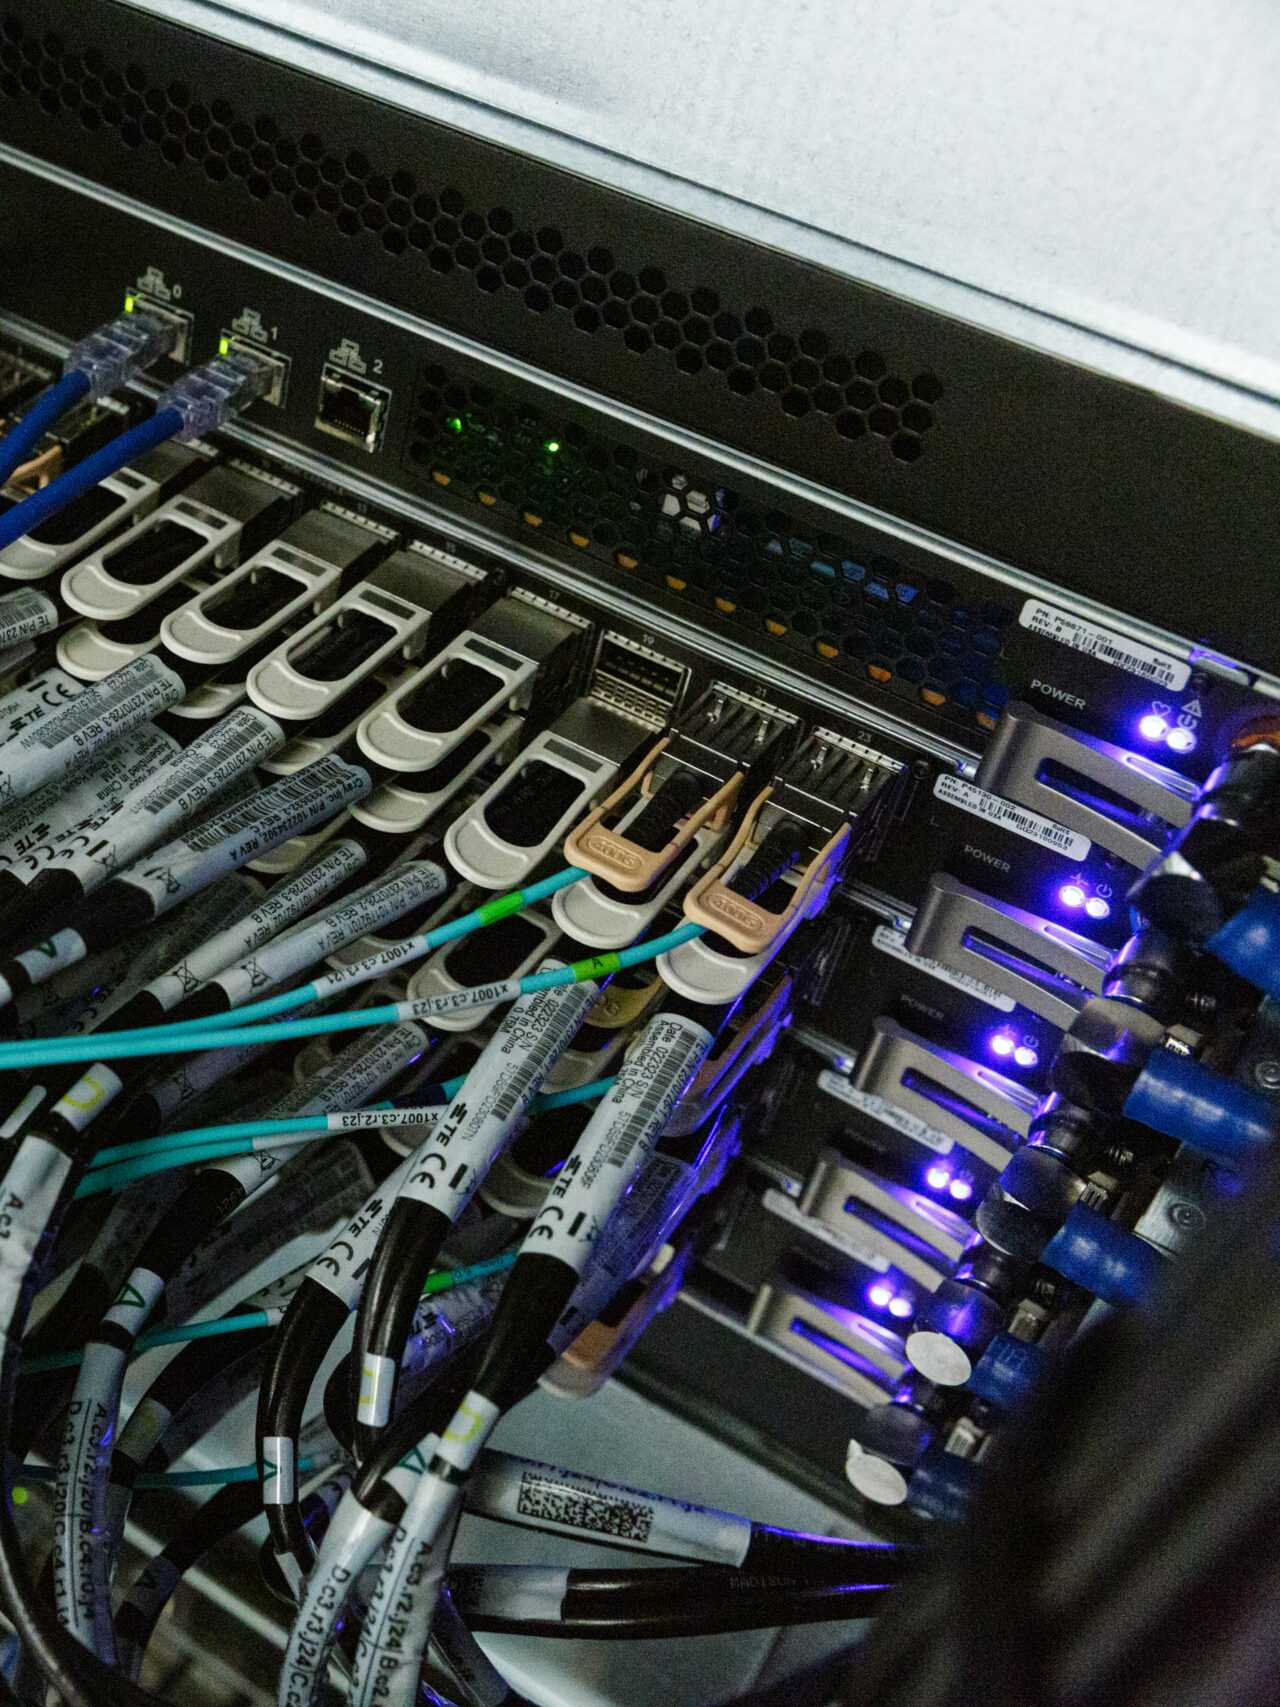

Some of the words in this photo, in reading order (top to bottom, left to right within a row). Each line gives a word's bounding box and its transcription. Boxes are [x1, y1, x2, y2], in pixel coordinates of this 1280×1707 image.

[170, 282, 184, 298] 0
[267, 324, 280, 340] 1
[370, 358, 385, 374] 2
[35, 613, 49, 627] TE
[641, 633, 655, 646] 19
[1081, 646, 1096, 657] USA
[134, 658, 151, 674] Date
[106, 669, 135, 692] 022123
[158, 676, 173, 690] TE
[142, 684, 161, 702] P/N
[754, 685, 768, 697] 21
[1030, 678, 1086, 710] POWER
[24, 705, 44, 723] TE
[236, 712, 254, 728] Date
[80, 721, 102, 740] REV
[201, 709, 245, 743] Assembled
[72, 733, 83, 746] B
[135, 731, 163, 756] Length
[261, 729, 275, 744] TE
[856, 729, 873, 744] 23
[245, 738, 264, 756] P/N
[128, 740, 171, 776] Assembled
[169, 748, 195, 769] China
[99, 759, 126, 781] 1.91M
[341, 766, 355, 780] TE
[97, 778, 122, 802] China
[184, 783, 207, 804] REV
[341, 774, 364, 795] Cray
[178, 798, 188, 810] B
[307, 799, 326, 815] P/N
[937, 787, 977, 810] ASSEMBLED
[987, 810, 1002, 821] USA
[6, 814, 32, 835] Zone
[90, 814, 109, 830] TE
[260, 809, 280, 827] REV
[249, 822, 259, 833] C
[14, 835, 34, 854] TE
[235, 837, 259, 857] REV
[338, 845, 353, 860] TE
[228, 848, 239, 861] A
[324, 854, 341, 870] P/N
[962, 844, 1012, 872] POWER
[399, 871, 418, 888] P/N
[417, 864, 432, 879] TE
[258, 897, 281, 917] REV
[335, 905, 357, 924] REV
[250, 912, 261, 924] B
[324, 916, 336, 929] B
[242, 935, 253, 946] A
[250, 923, 271, 941] REV
[325, 929, 346, 946] REV
[316, 939, 327, 950] A
[412, 985, 507, 1014] x1007.c3.r3.j23
[530, 997, 558, 1033] 022323
[500, 1025, 526, 1056] China
[518, 1030, 538, 1053] S/N
[661, 1021, 682, 1045] Date
[632, 1019, 667, 1068] Assembled
[640, 1044, 668, 1081] 022323
[325, 1074, 346, 1093] REV
[611, 1076, 633, 1104] China
[629, 1079, 647, 1099] S/N
[316, 1087, 329, 1100] B
[435, 1121, 456, 1146] TE
[551, 1176, 570, 1198] TE
[349, 1211, 376, 1239] TE
[289, 1565, 350, 1668] D.c3.r3.j24
